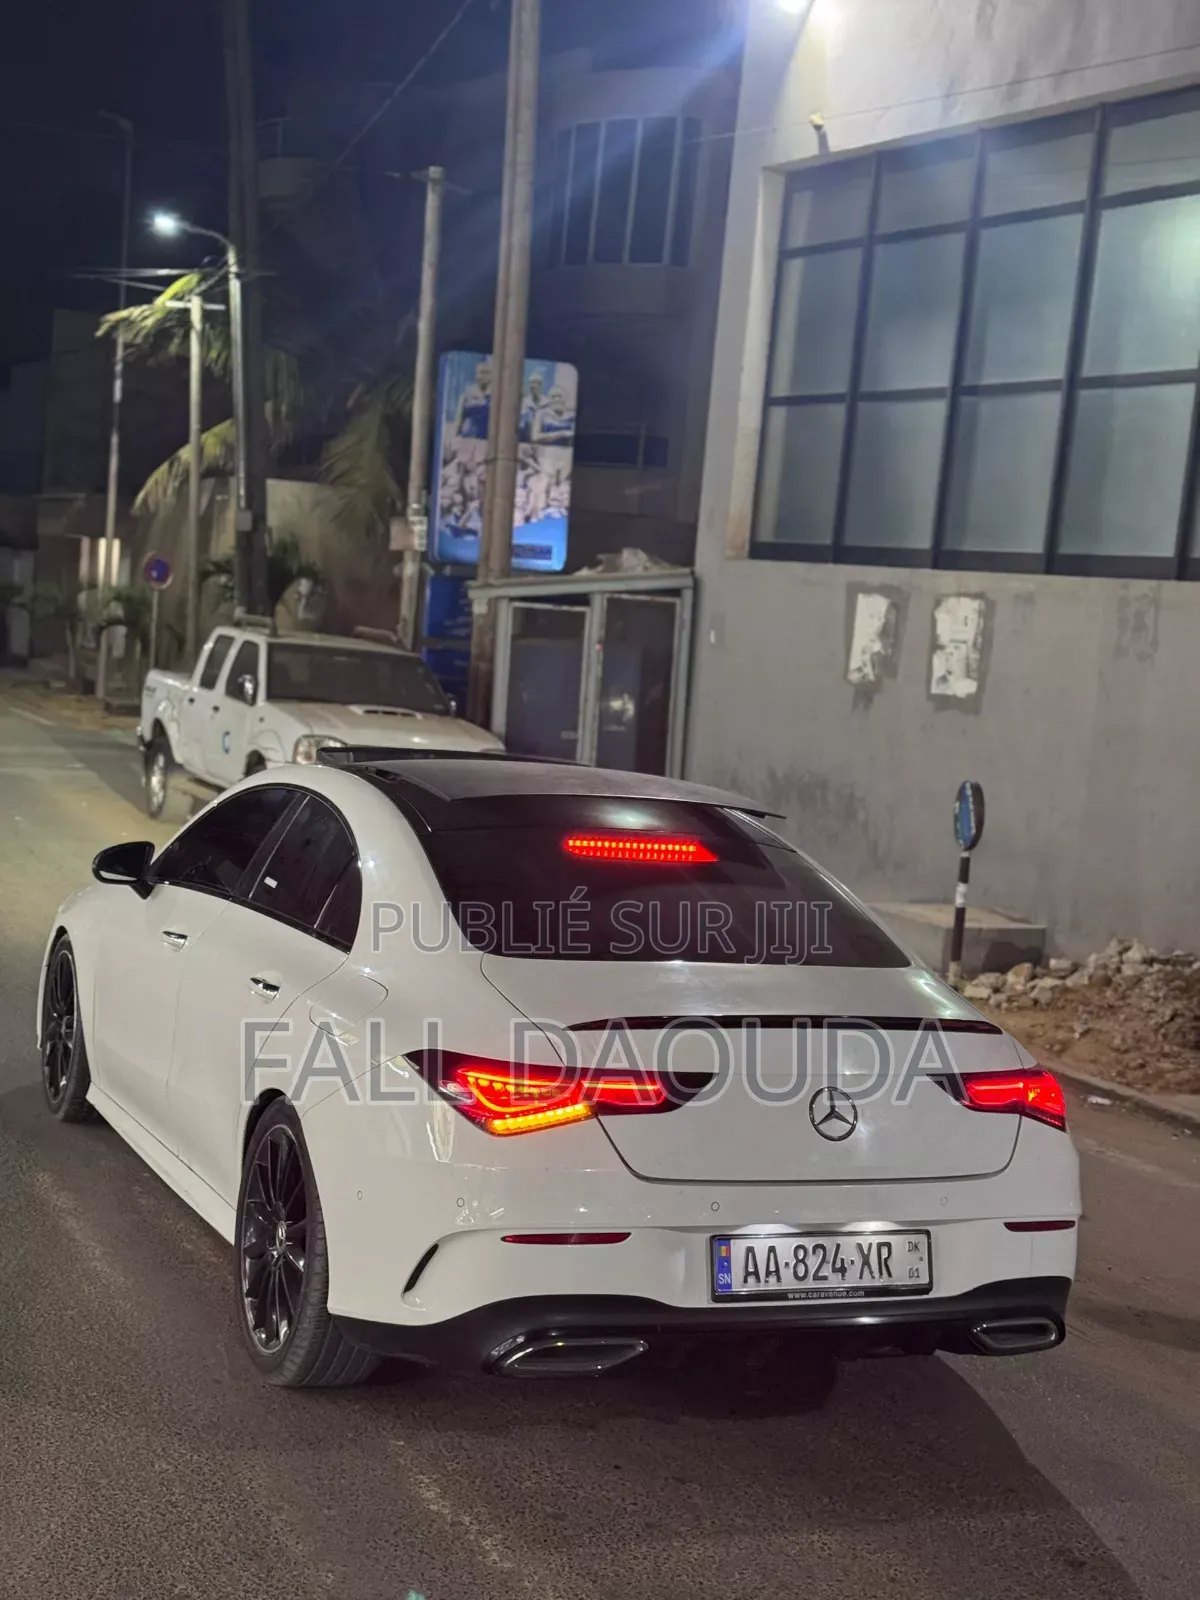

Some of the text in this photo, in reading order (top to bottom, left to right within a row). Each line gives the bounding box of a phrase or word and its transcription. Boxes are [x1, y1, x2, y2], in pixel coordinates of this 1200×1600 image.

[907, 1241, 920, 1252] DK
[718, 1272, 731, 1285] SN
[908, 1267, 920, 1279] 01
[787, 1290, 865, 1299] www.caravenue.com
